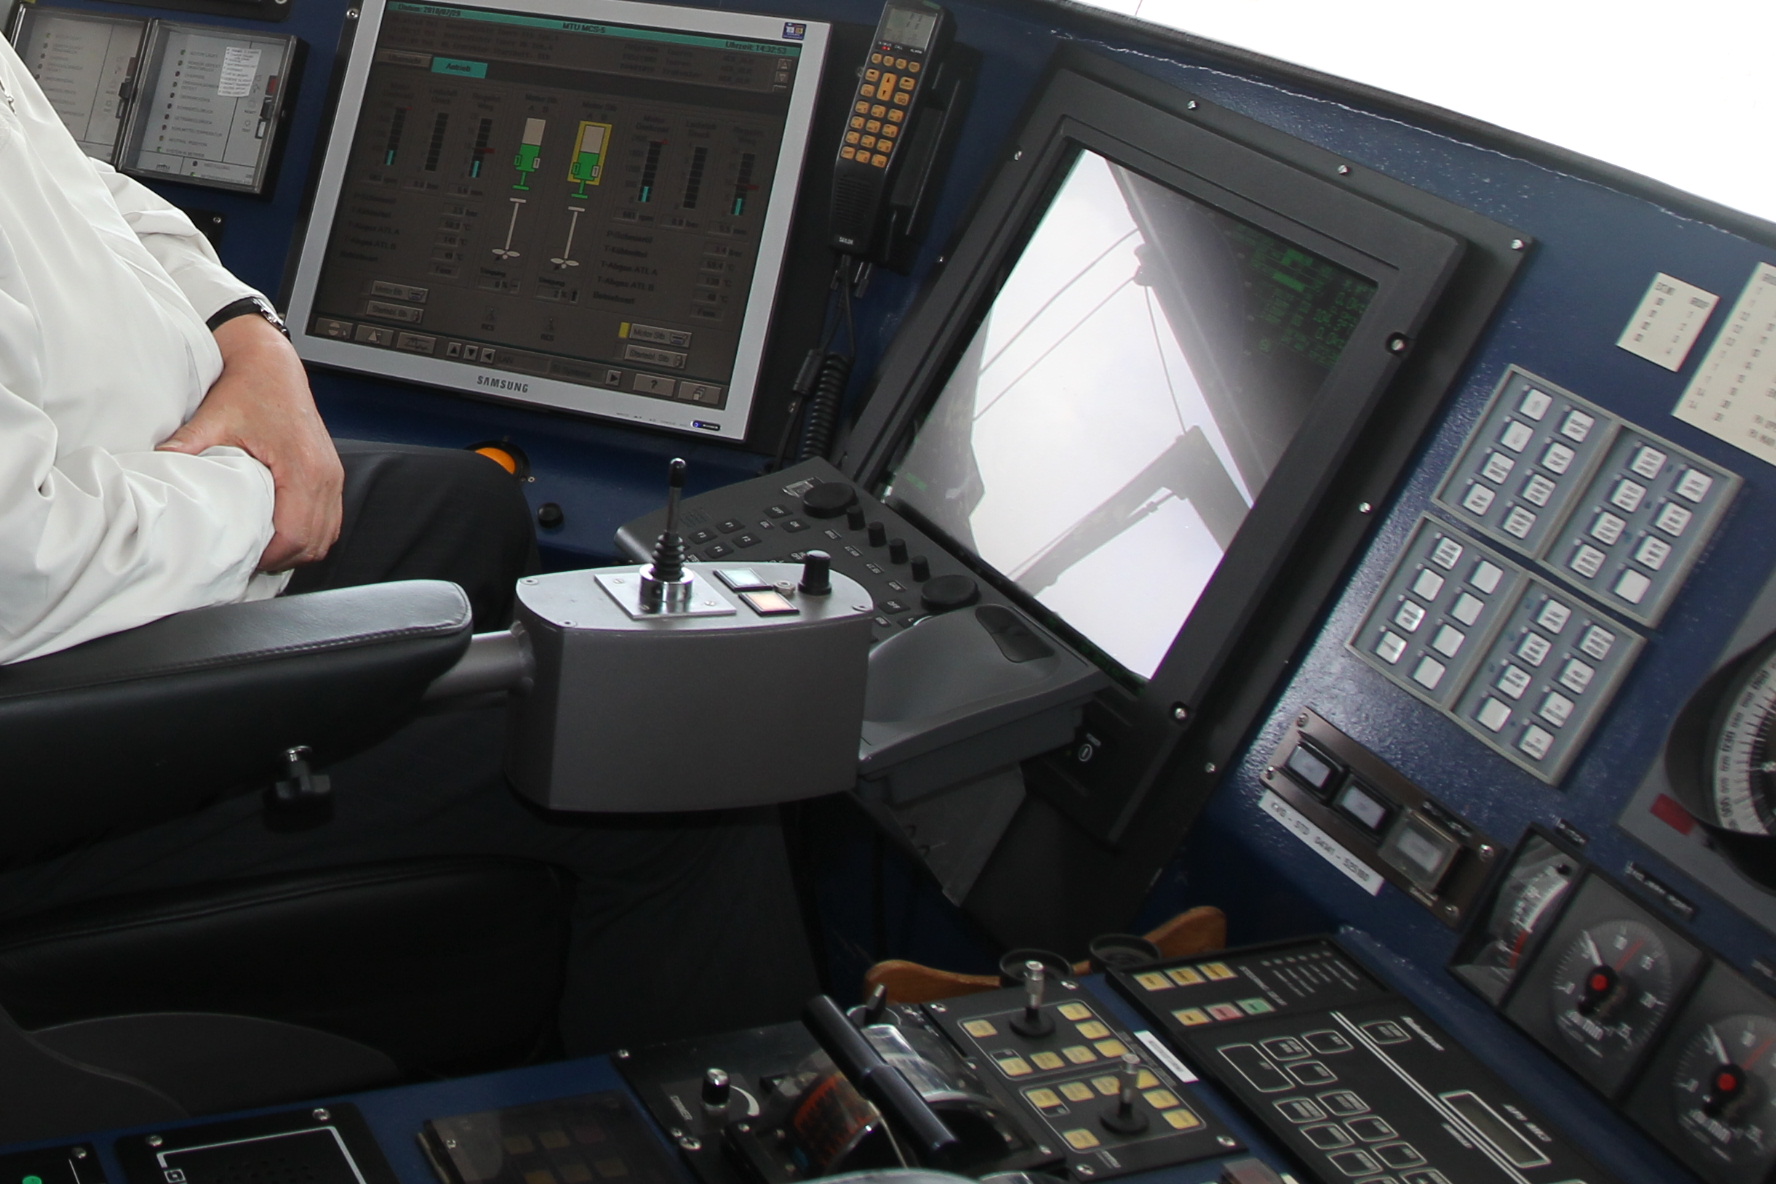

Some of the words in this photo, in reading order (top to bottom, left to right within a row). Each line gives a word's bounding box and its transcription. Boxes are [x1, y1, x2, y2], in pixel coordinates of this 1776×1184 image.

[562, 22, 580, 31] MTU
[582, 24, 606, 34] MCS-5
[725, 41, 753, 52] Uhrzeit:
[756, 44, 787, 55] 14:32:53
[445, 62, 472, 73] Antrieb
[476, 375, 529, 394] SAMSUNG
[697, 531, 707, 539] F3
[742, 535, 751, 543] F2
[714, 545, 724, 553] F4
